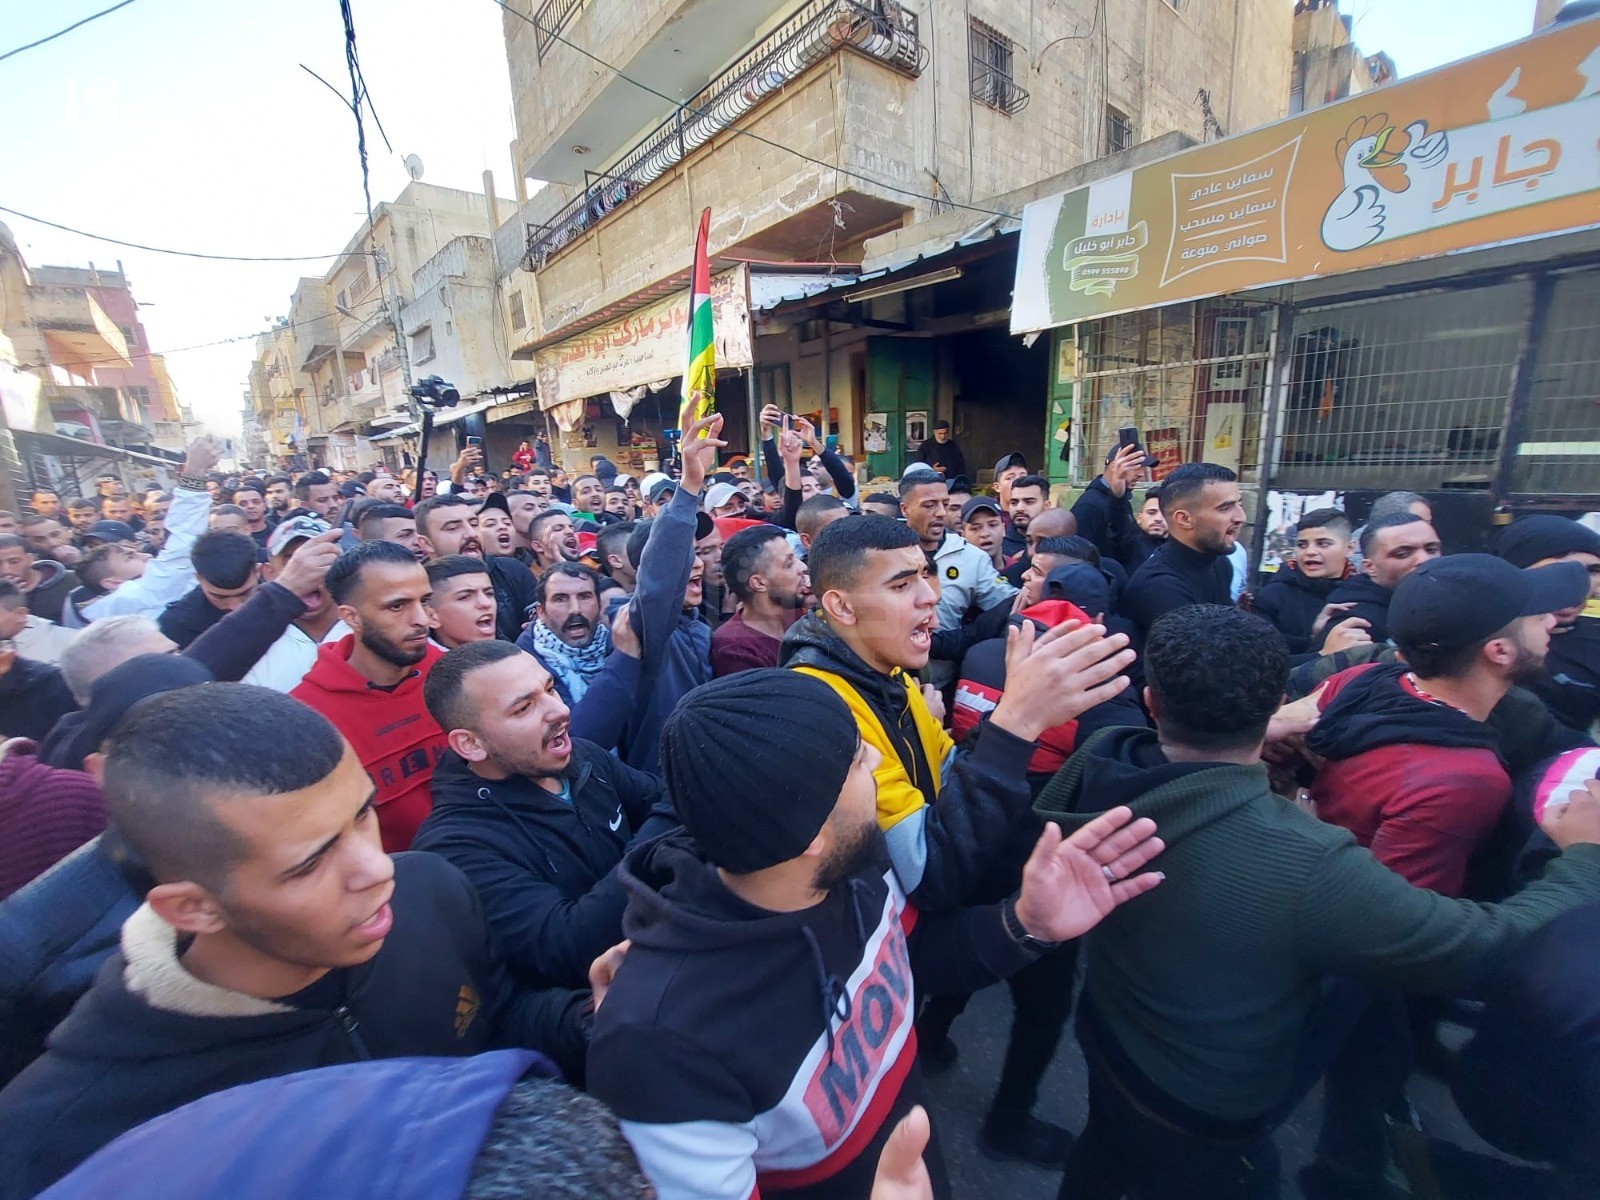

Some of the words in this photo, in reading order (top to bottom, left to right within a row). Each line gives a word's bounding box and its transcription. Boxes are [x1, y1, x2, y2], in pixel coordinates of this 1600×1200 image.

[1431, 134, 1562, 213] جابر
[1189, 182, 1222, 201] عادي
[1074, 239, 1097, 255] خليل
[1115, 235, 1136, 250] جابر
[1223, 234, 1268, 252] صواني
